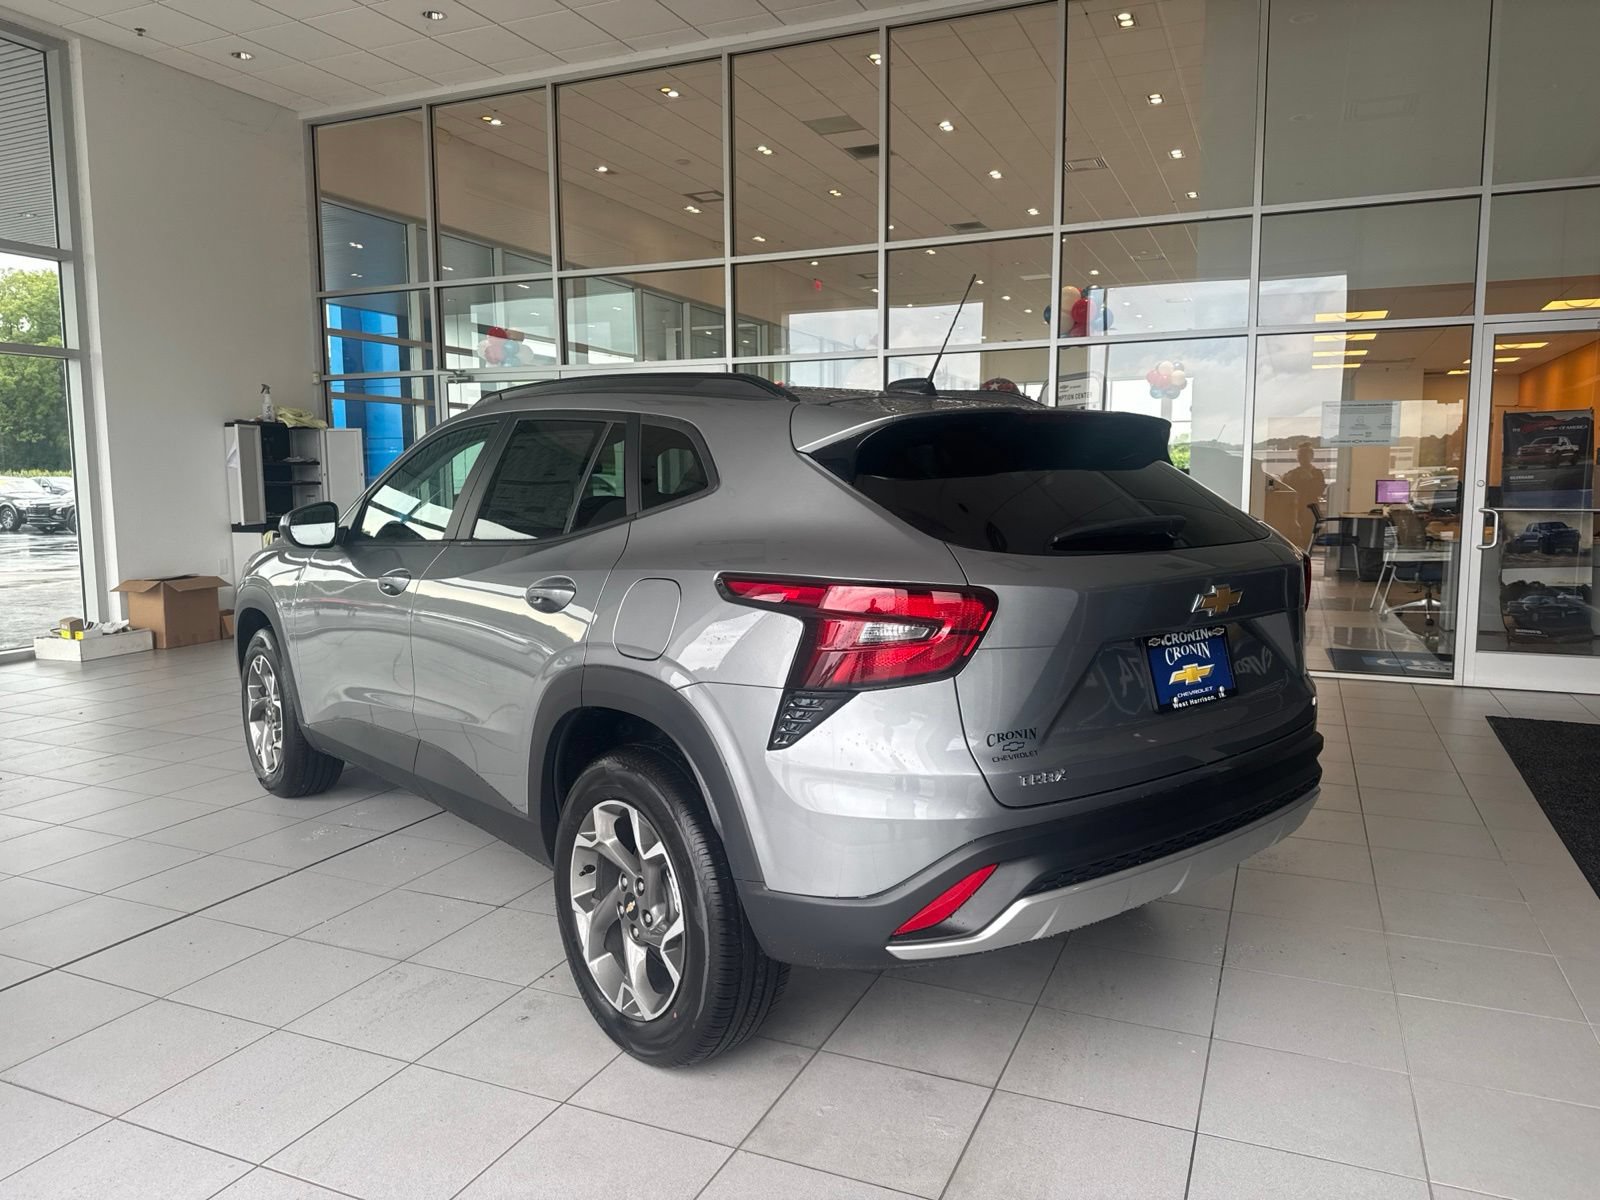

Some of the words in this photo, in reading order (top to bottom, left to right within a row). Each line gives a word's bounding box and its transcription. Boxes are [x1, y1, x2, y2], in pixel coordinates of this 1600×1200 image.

[1164, 628, 1208, 645] CRONIN
[1165, 641, 1211, 666] CRONIN
[1177, 686, 1214, 699] CHEVROLET
[1172, 701, 1189, 709] West
[986, 727, 1037, 748] CRONIN
[992, 750, 1038, 763] CHEVROLET
